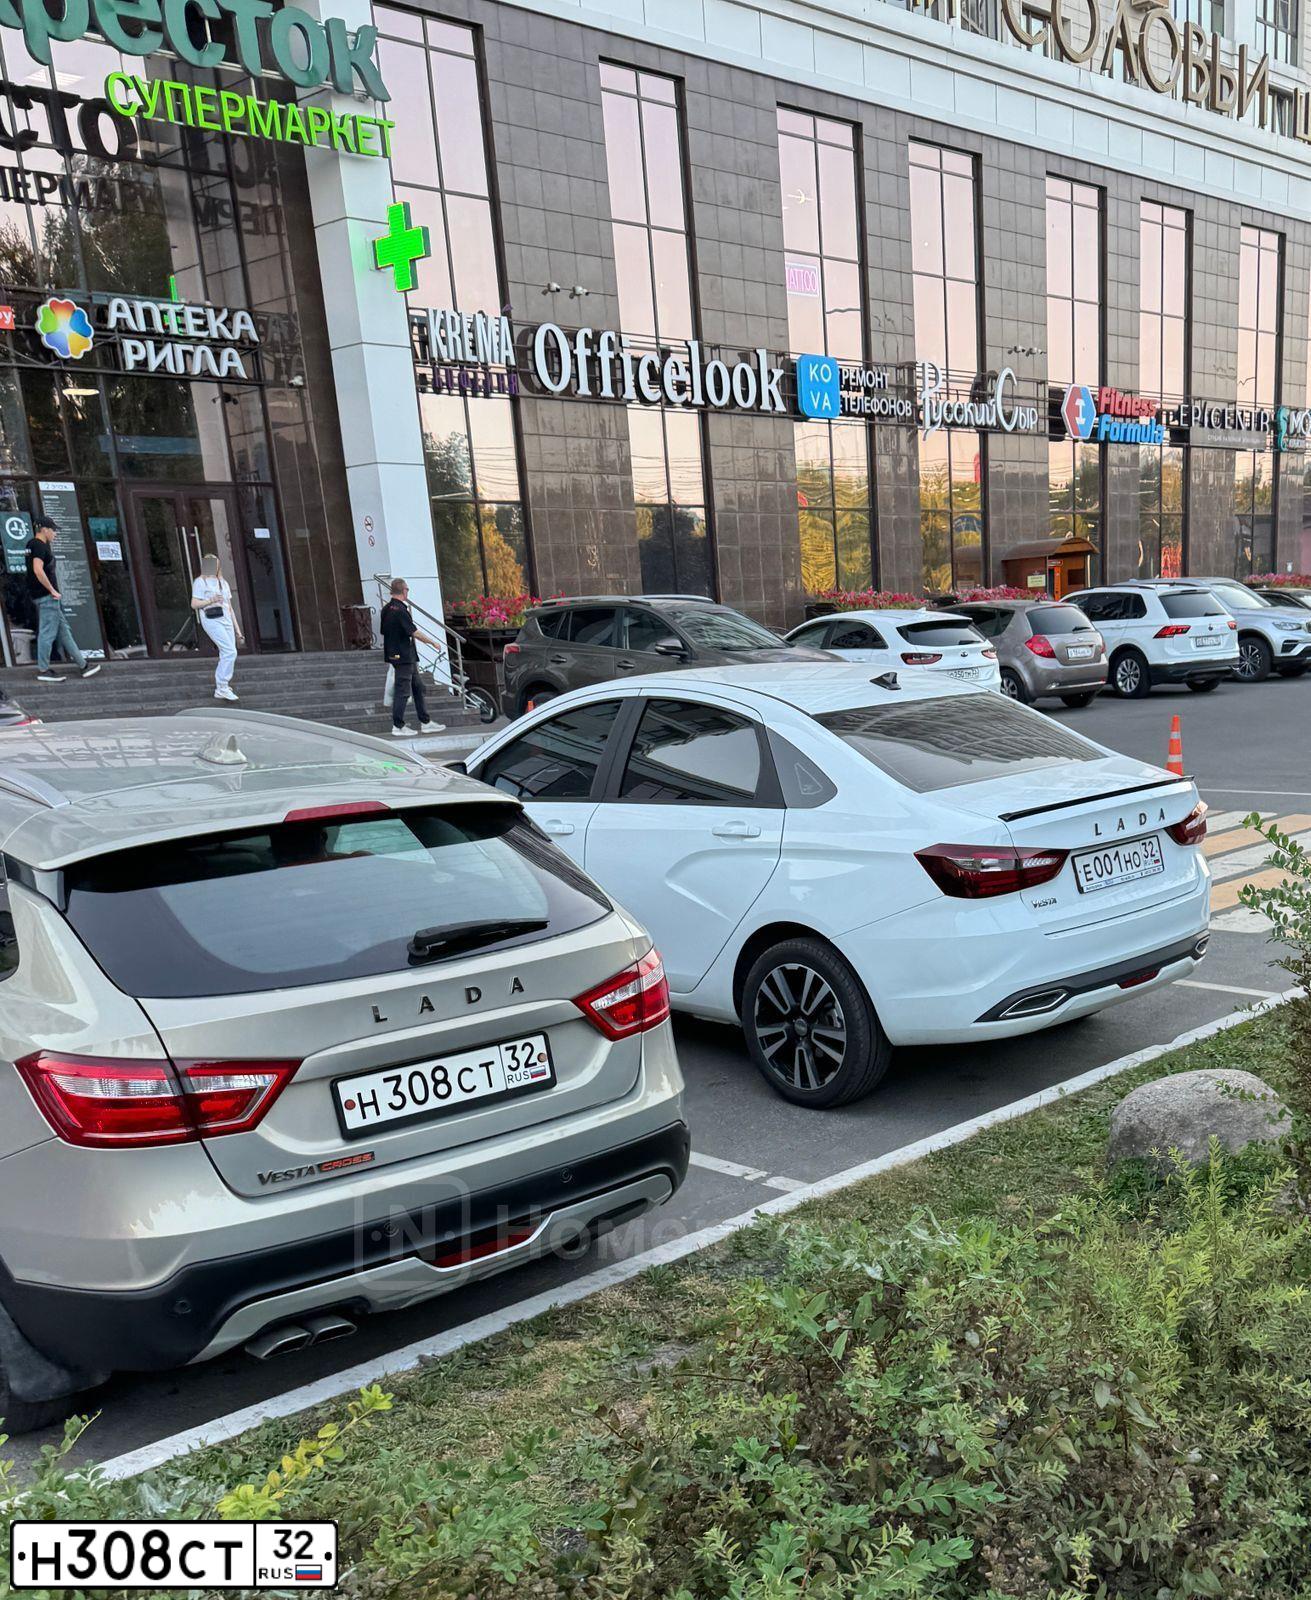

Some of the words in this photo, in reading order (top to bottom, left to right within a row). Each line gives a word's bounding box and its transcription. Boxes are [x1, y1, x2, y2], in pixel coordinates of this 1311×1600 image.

[0, 0, 390, 101] ресток
[106, 72, 395, 158] СУПЕРМАРКЕТ
[107, 297, 260, 343] АПТЕКА
[427, 307, 516, 366] KREMA
[122, 338, 248, 380] РИГЛА
[534, 322, 787, 413] Officelook
[809, 364, 832, 382] KO
[842, 367, 890, 389] РЕМОНТ
[810, 392, 832, 411] VA
[842, 395, 912, 416] ТЕЛЕФОНОВ
[916, 361, 996, 441] Русский
[996, 367, 1038, 432] Сыр
[1098, 386, 1158, 417] Fitness
[1097, 413, 1163, 443] Formula
[1180, 403, 1270, 436] EPICENTR
[1095, 807, 1165, 836] LADA
[1083, 850, 1141, 882] Е001НО
[1141, 840, 1156, 859] 32
[1031, 897, 1057, 908] VESTA
[371, 976, 525, 1023] LADA
[357, 1061, 495, 1120] Н308СТ
[505, 1042, 538, 1071] 32
[507, 1073, 531, 1085] RUS
[257, 1165, 316, 1185] VESTA
[320, 1152, 374, 1172] CROSS
